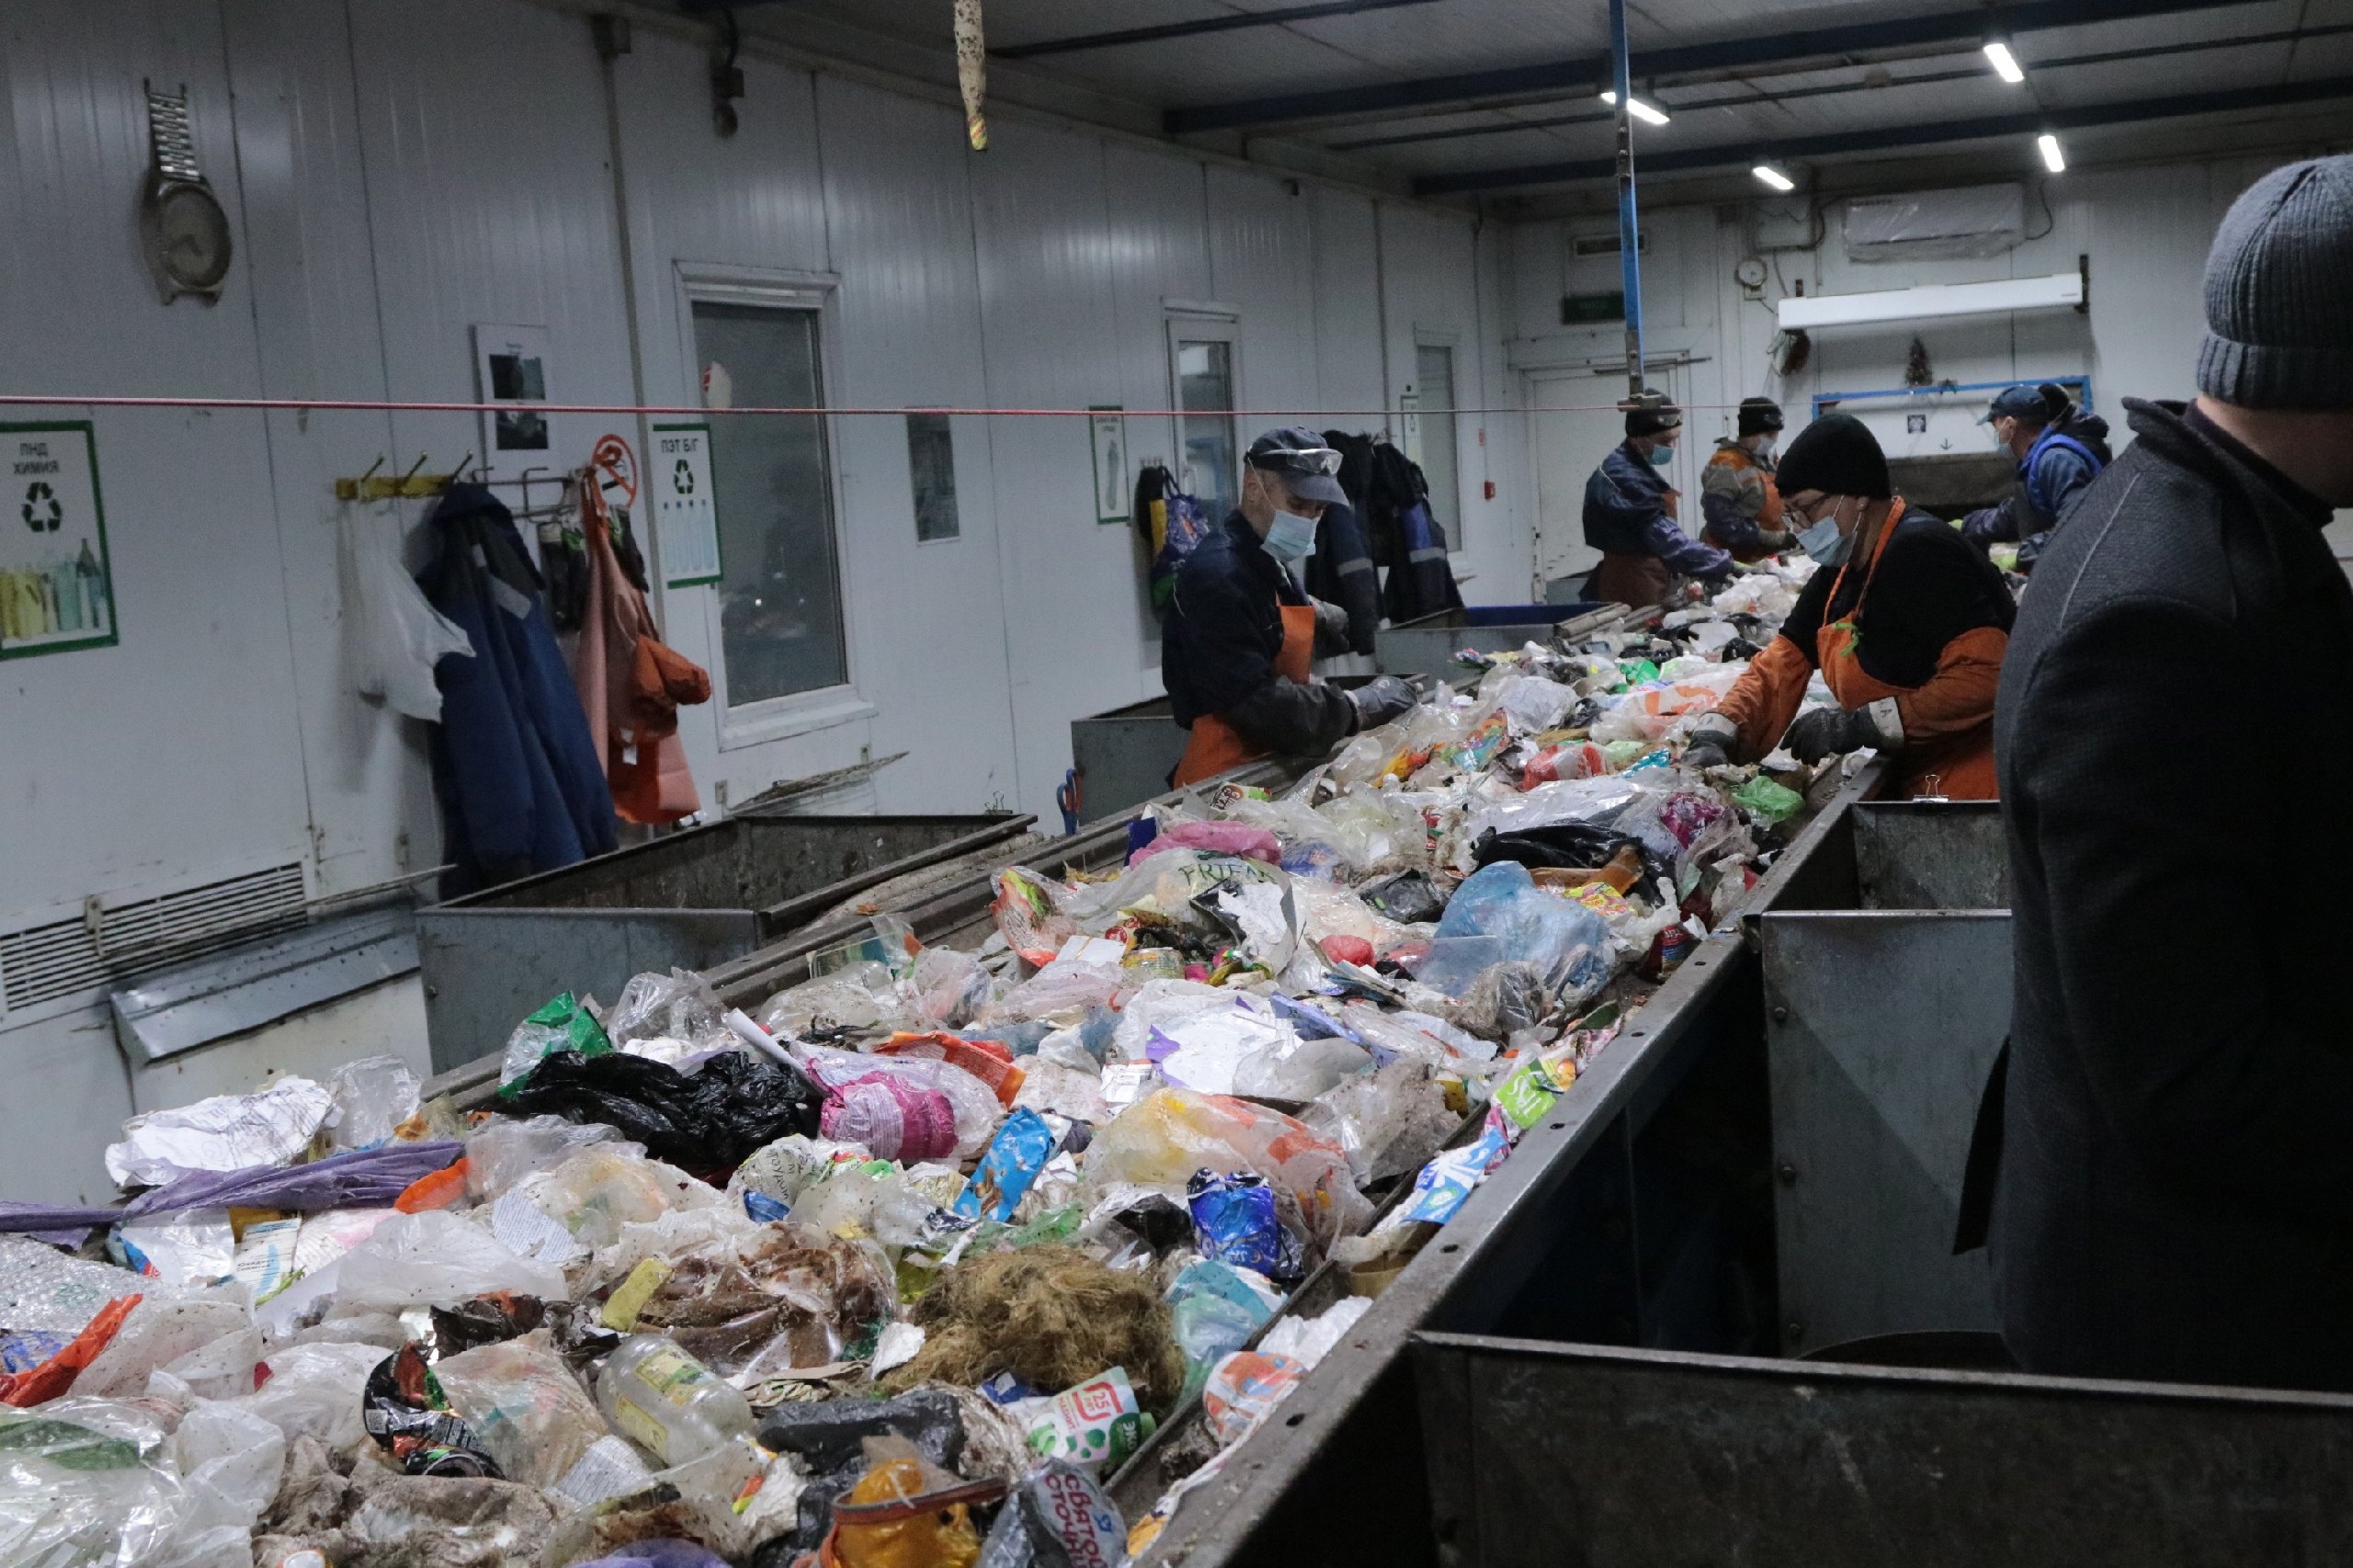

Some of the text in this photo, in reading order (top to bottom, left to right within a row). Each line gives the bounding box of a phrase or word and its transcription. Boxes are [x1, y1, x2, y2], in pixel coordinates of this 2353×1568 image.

[20, 442, 48, 457] ПНД
[661, 438, 680, 453] ПЭТ
[13, 460, 61, 475] ХИМИЯ
[1092, 1391, 1111, 1409] 25
